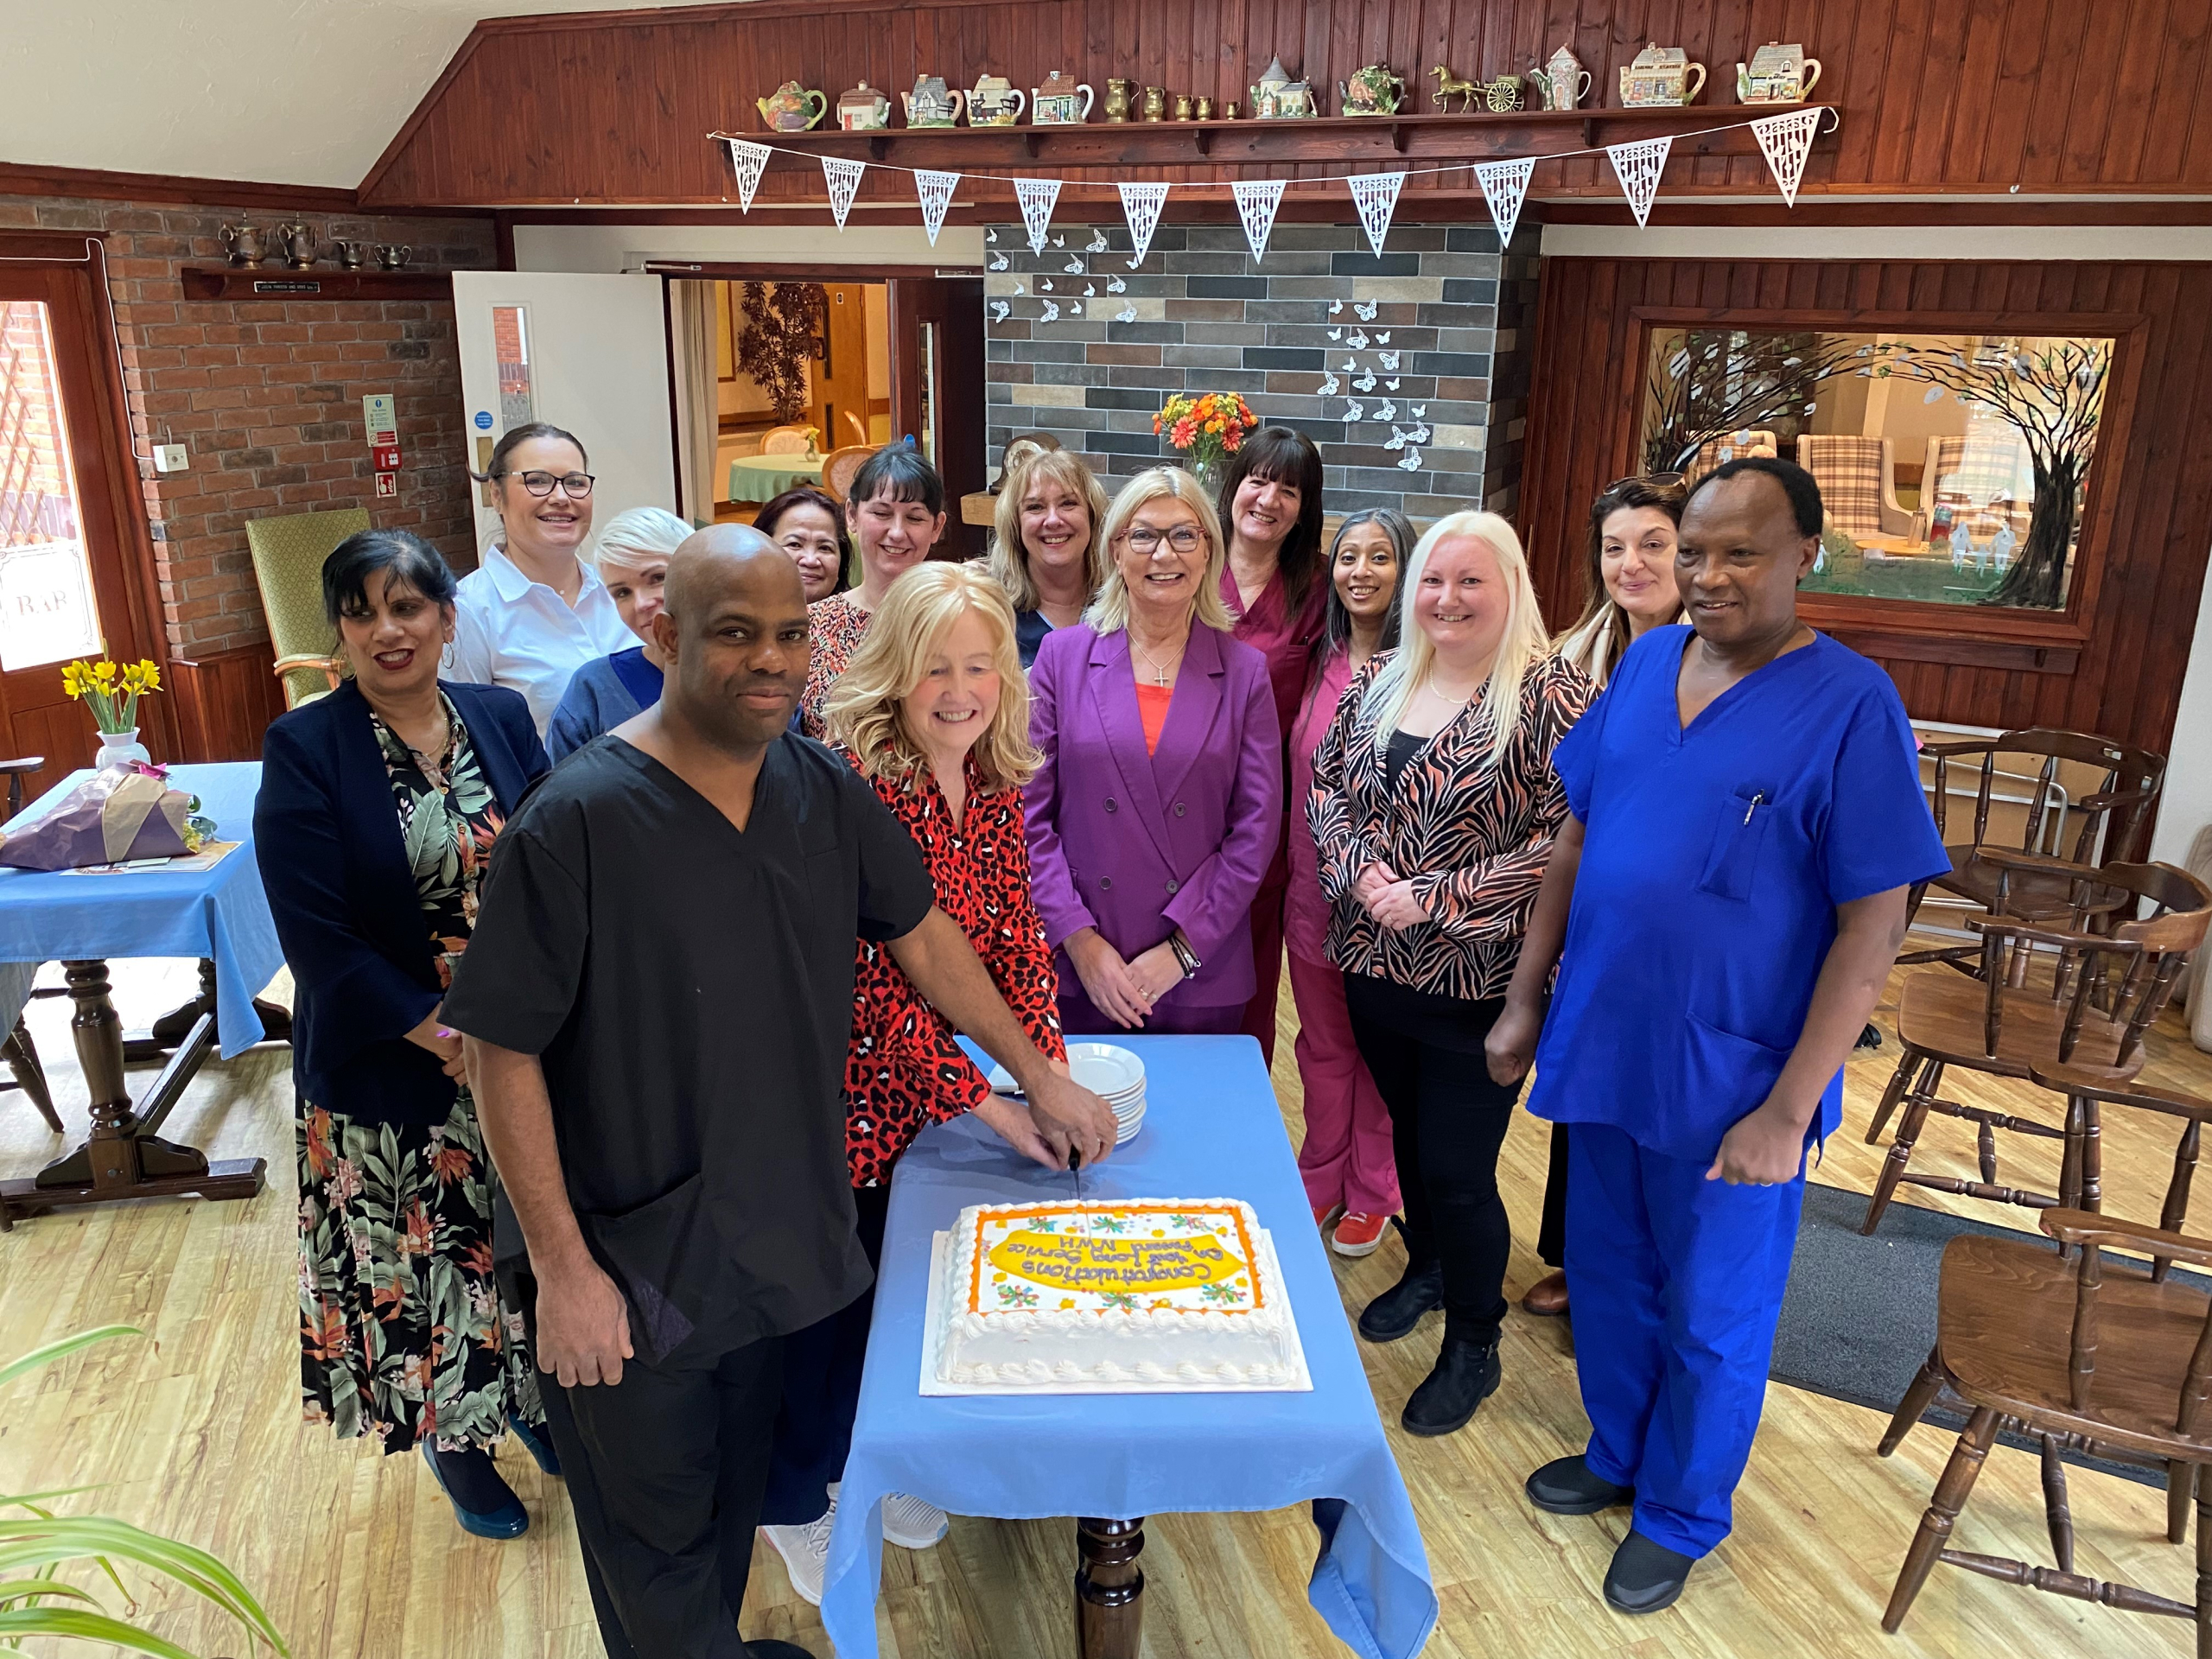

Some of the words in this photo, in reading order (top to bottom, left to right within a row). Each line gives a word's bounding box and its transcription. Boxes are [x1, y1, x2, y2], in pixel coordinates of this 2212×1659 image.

[1007, 1243, 1082, 1264] Service
[1091, 1249, 1141, 1268] Long
[1192, 1248, 1224, 1262] On
[1020, 1259, 1212, 1287] Congratulations
